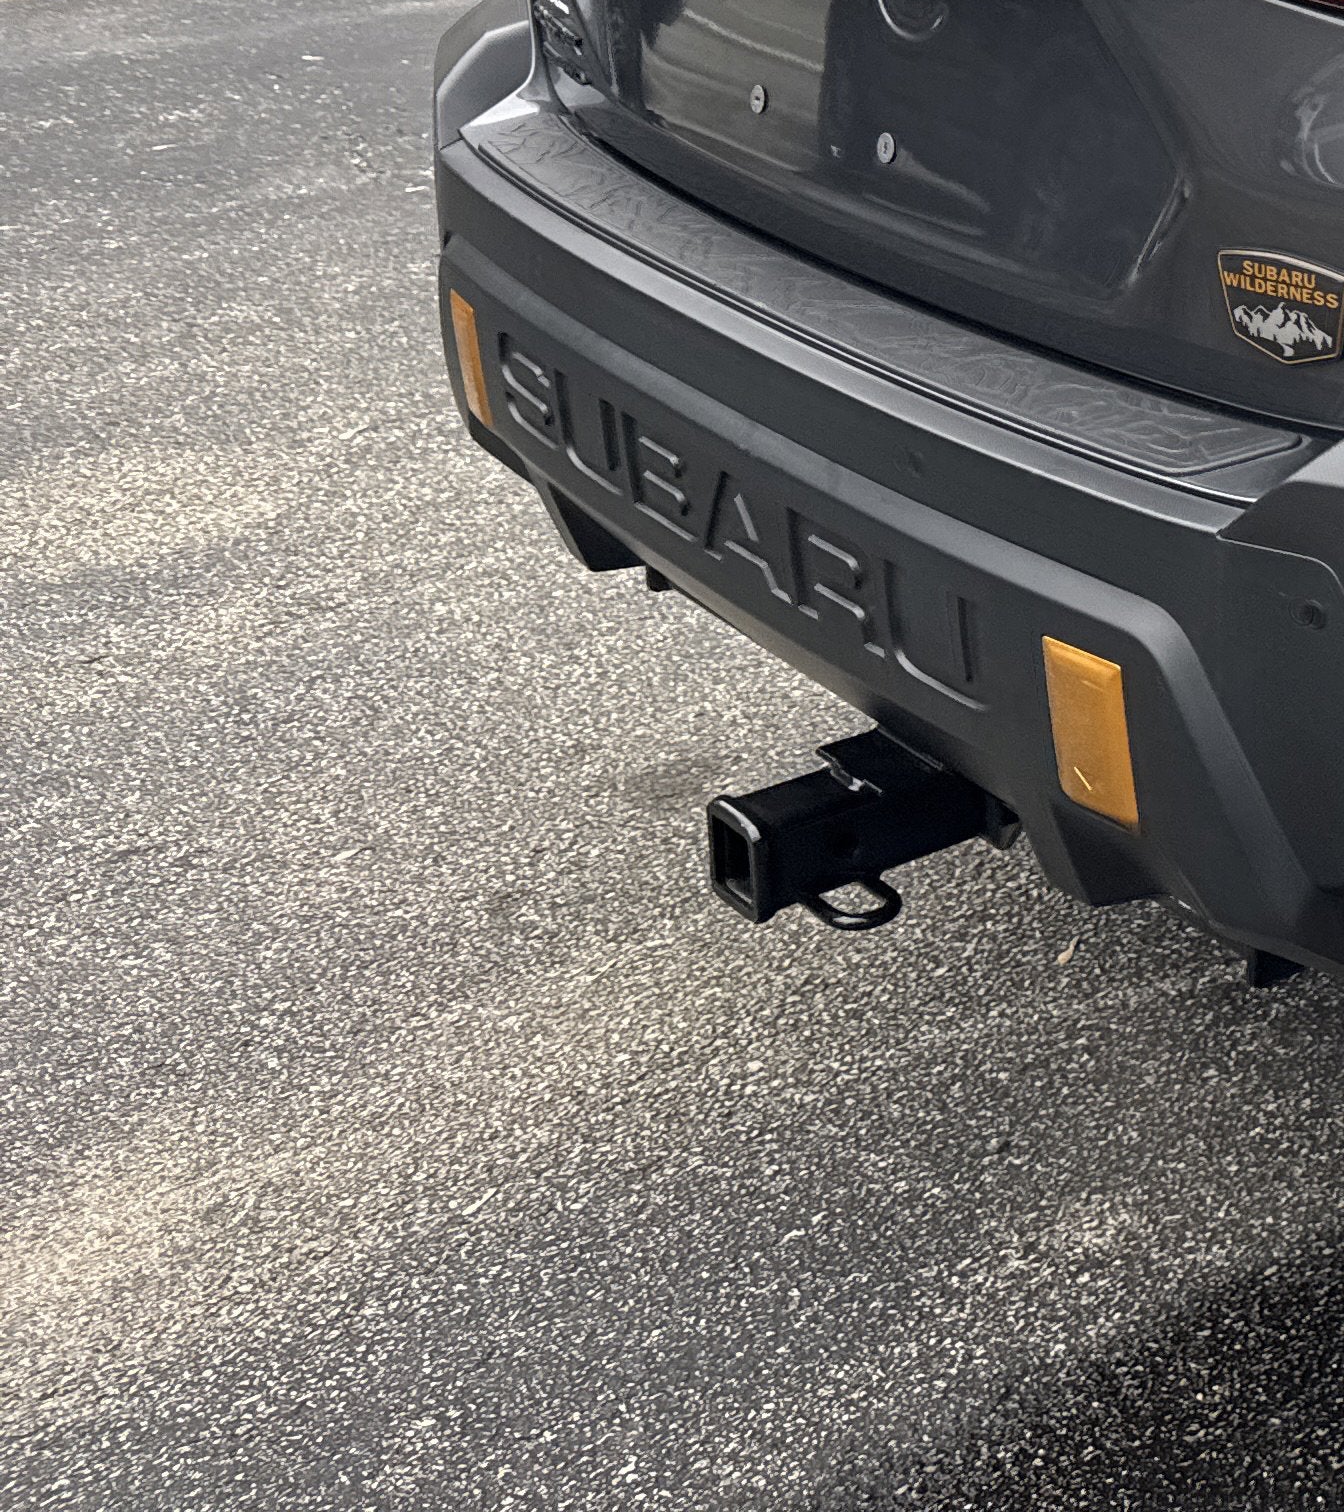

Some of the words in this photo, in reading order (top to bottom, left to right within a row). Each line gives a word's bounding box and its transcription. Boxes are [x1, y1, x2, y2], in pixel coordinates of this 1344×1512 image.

[1224, 271, 1339, 309] WILDERNESS
[1242, 260, 1316, 289] SUBARU
[498, 330, 990, 712] SUBARU
